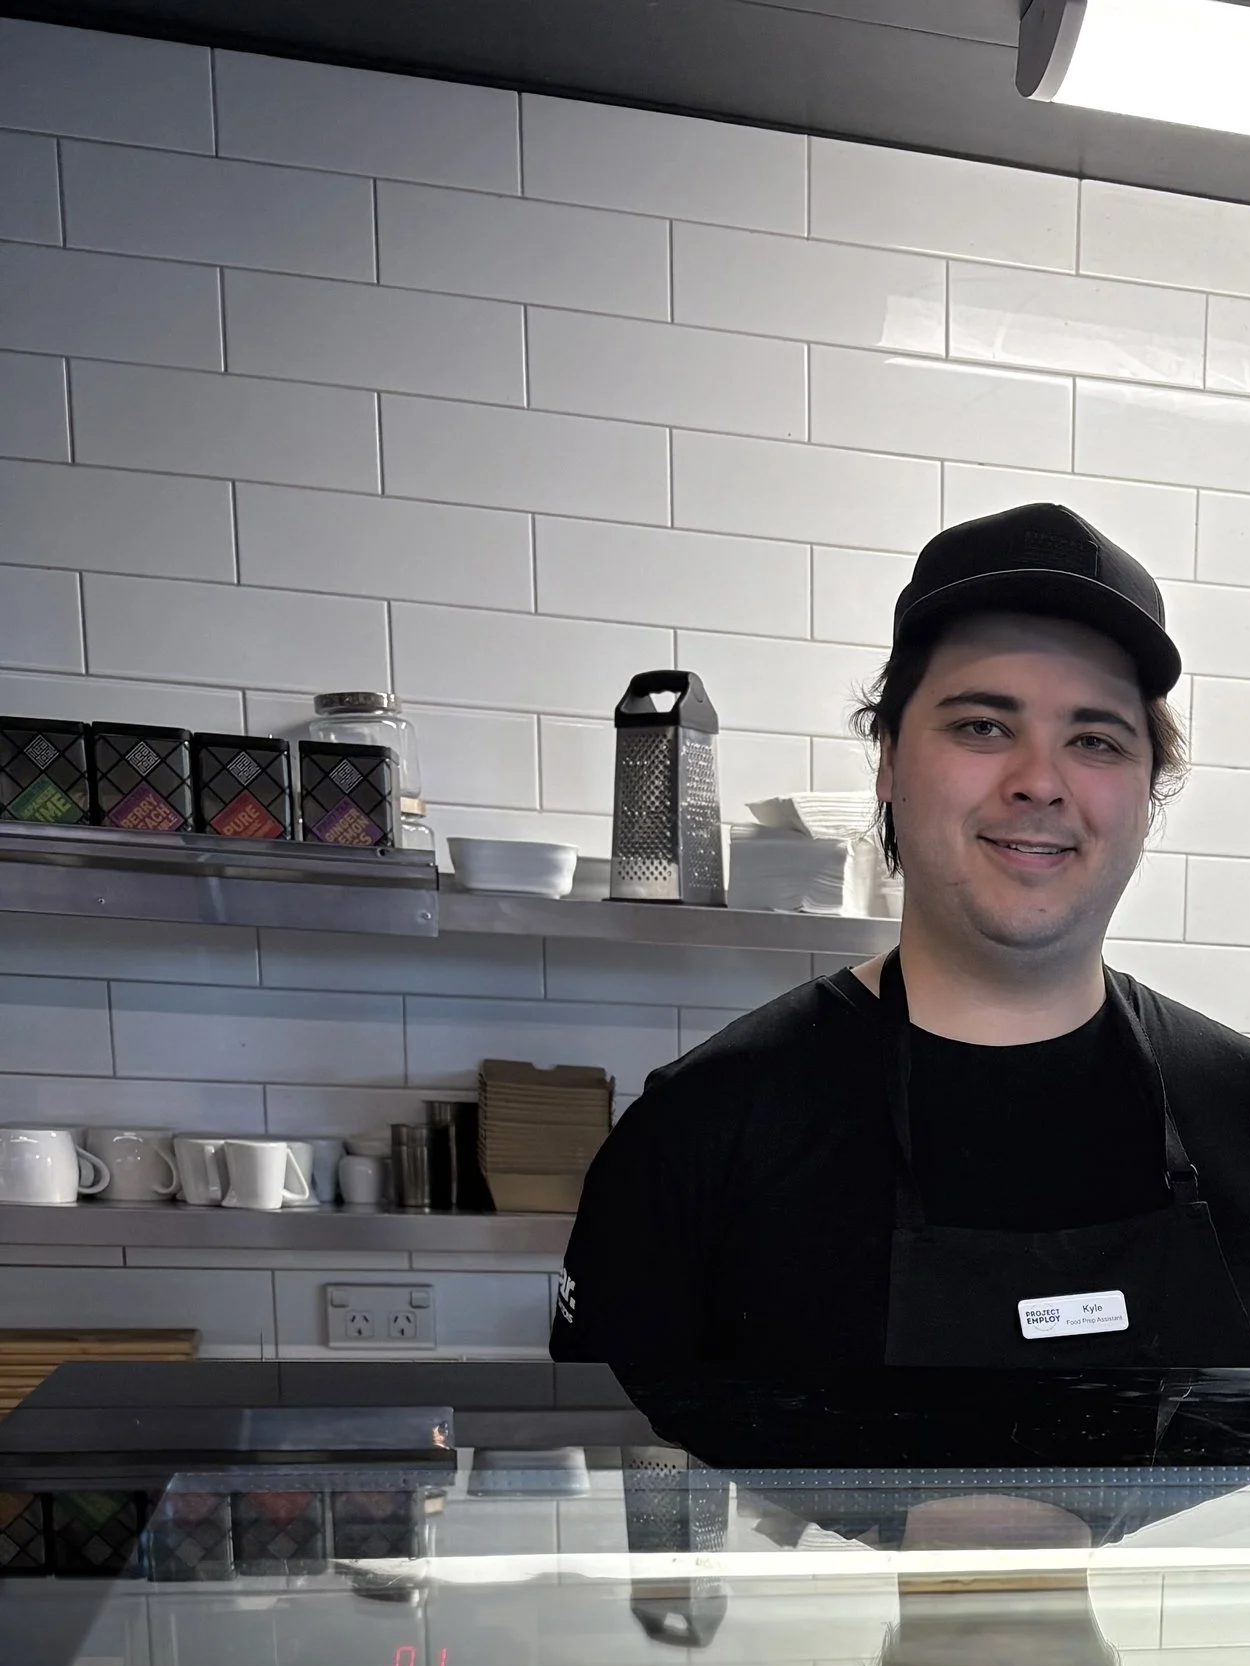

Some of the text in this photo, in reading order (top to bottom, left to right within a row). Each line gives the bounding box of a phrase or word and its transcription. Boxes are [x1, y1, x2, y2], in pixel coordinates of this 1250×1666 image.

[223, 803, 261, 836] PURE
[324, 807, 360, 842] GINGER
[1025, 1307, 1060, 1318] PROJECT
[1082, 1303, 1103, 1315] Kyle
[1026, 1314, 1061, 1325] EMPLOY
[1066, 1314, 1123, 1326] Food Prep Assistant
